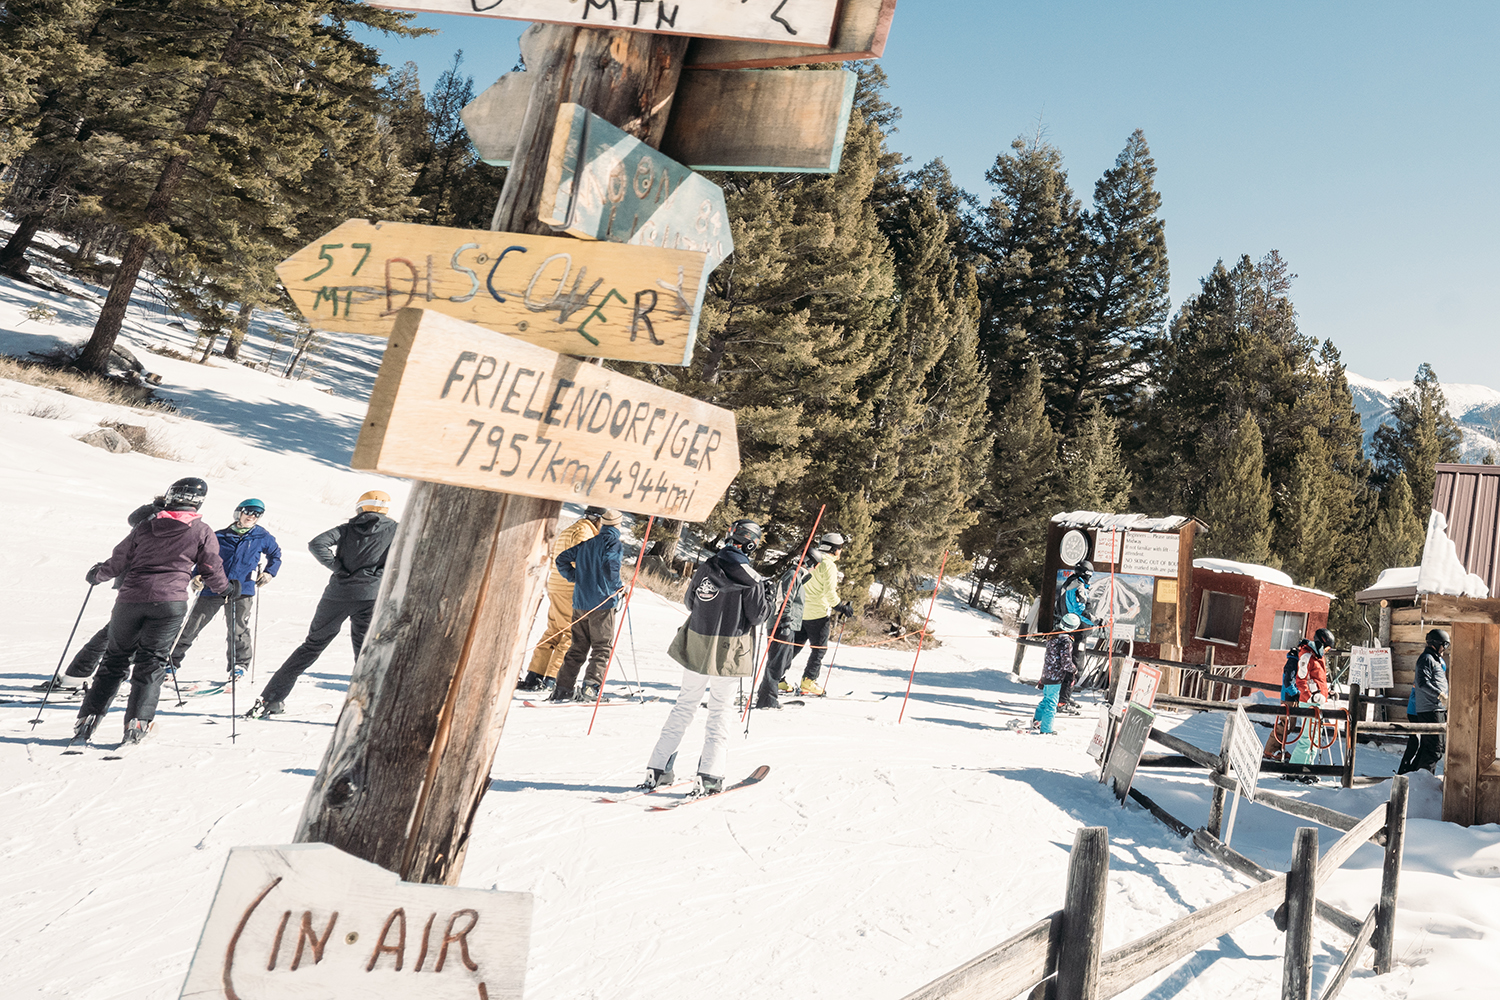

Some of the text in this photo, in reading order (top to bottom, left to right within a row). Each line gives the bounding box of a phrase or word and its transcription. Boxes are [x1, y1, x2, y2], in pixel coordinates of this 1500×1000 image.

[303, 243, 372, 282] 57
[312, 286, 353, 317] MI
[379, 242, 694, 346] DISCOVERY
